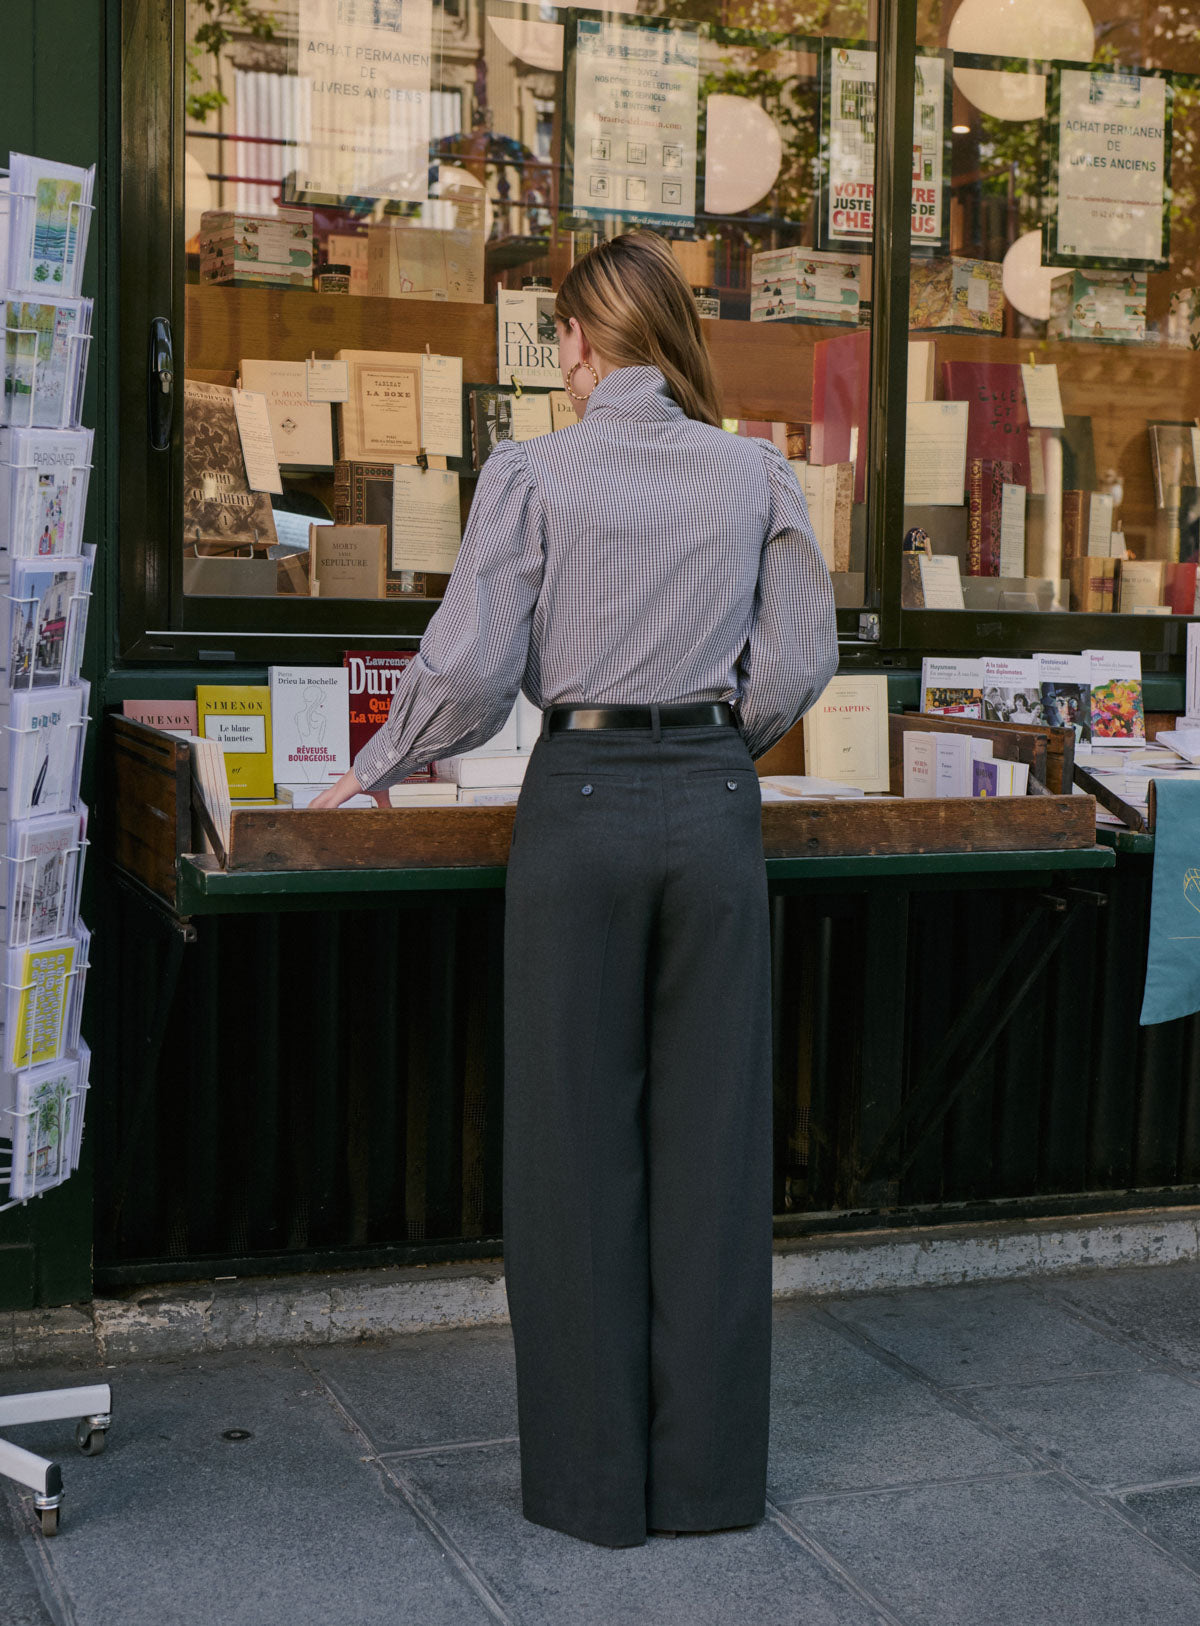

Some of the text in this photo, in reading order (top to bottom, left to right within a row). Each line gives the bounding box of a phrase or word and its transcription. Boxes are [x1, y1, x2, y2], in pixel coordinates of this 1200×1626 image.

[307, 41, 352, 57] ACHAT
[361, 66, 377, 79] DE
[312, 80, 422, 104] LIVRES ANCIENS
[1066, 120, 1100, 133] ACHAT
[1107, 140, 1120, 151] DE
[1109, 158, 1156, 172] ANCIENS
[833, 198, 871, 211] JUSTE
[920, 204, 935, 215] DE
[833, 210, 935, 233] CHE US
[505, 322, 534, 344] EX
[34, 452, 76, 466] PARISIANER
[365, 656, 409, 666] Lawrence
[206, 701, 264, 710] SIMENON
[350, 712, 366, 723] La
[220, 724, 251, 732] Le blanc
[224, 734, 253, 742] lunettes
[296, 746, 328, 754] RÊVEUSE
